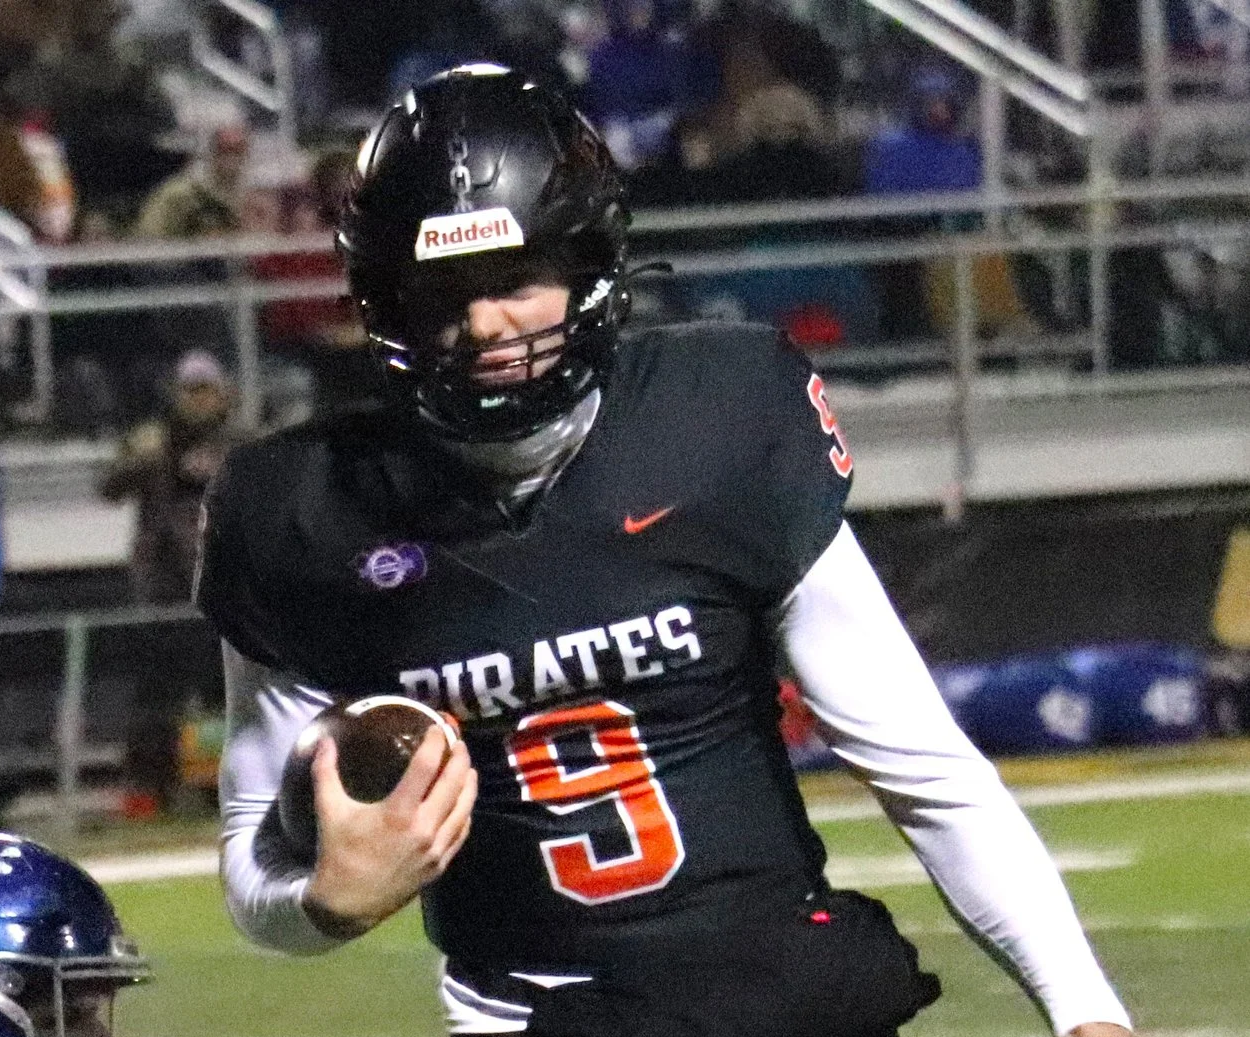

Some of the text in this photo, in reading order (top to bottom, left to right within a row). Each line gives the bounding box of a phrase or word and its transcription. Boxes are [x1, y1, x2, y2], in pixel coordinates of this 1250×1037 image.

[423, 219, 509, 249] Riddell
[399, 605, 702, 723] PIRATES
[506, 700, 686, 906] 9
